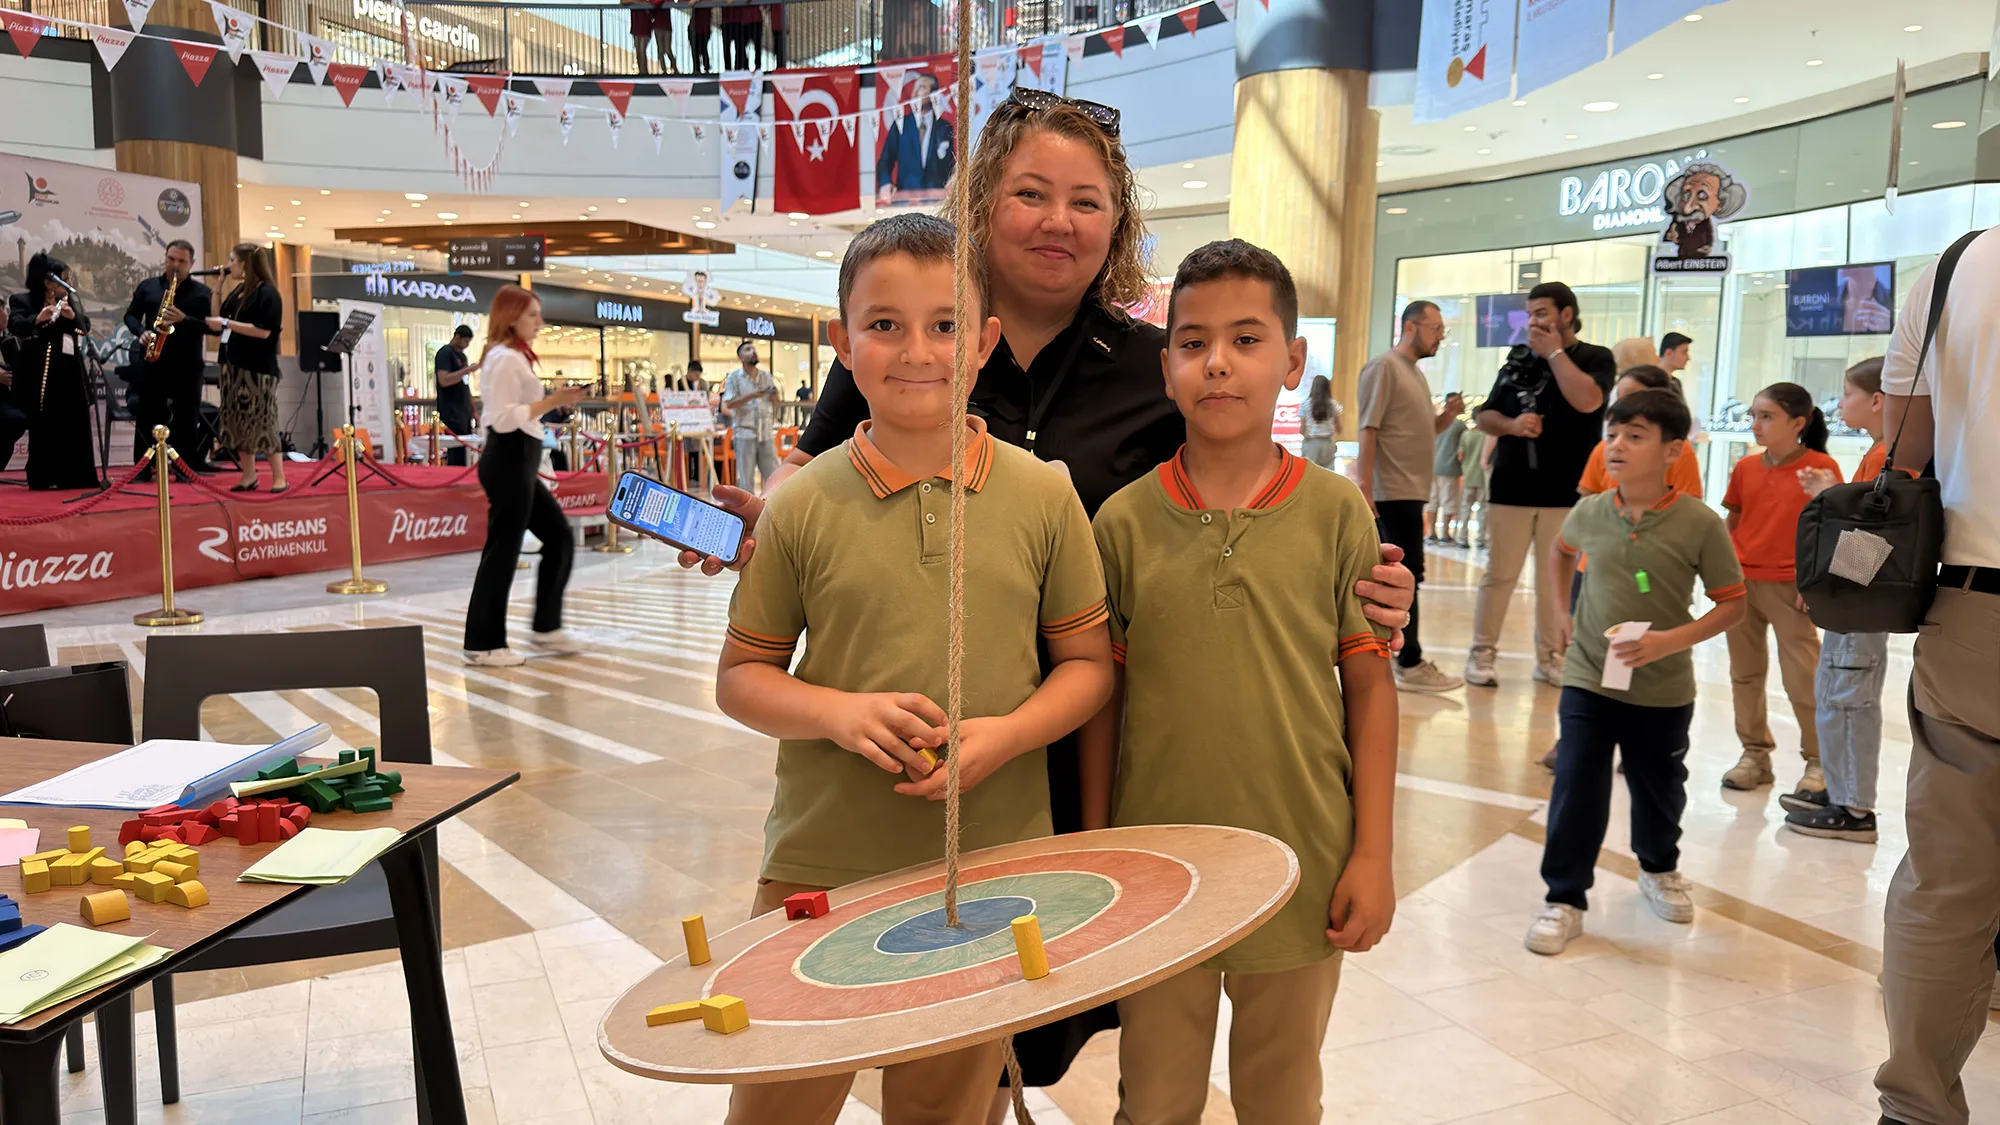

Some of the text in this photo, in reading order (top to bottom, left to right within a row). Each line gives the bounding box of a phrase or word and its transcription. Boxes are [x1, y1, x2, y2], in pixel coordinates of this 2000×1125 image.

[9, 21, 43, 34] Piazza
[419, 16, 480, 53] cardin
[96, 34, 126, 47] Piazza
[181, 51, 210, 63] Piazza
[262, 63, 289, 75] Piazza
[333, 74, 360, 85] Piazza
[1656, 258, 1727, 270] Albert EINSTEIN
[391, 278, 477, 303] KARACA
[596, 300, 643, 322] NİHAN
[746, 316, 776, 336] TUĞBA
[557, 494, 596, 508] NESANS
[238, 518, 327, 542] RÖNESANS
[388, 508, 469, 544] Piazza
[238, 540, 328, 562] GAYRİMENKUL
[0, 551, 114, 590] iazza
